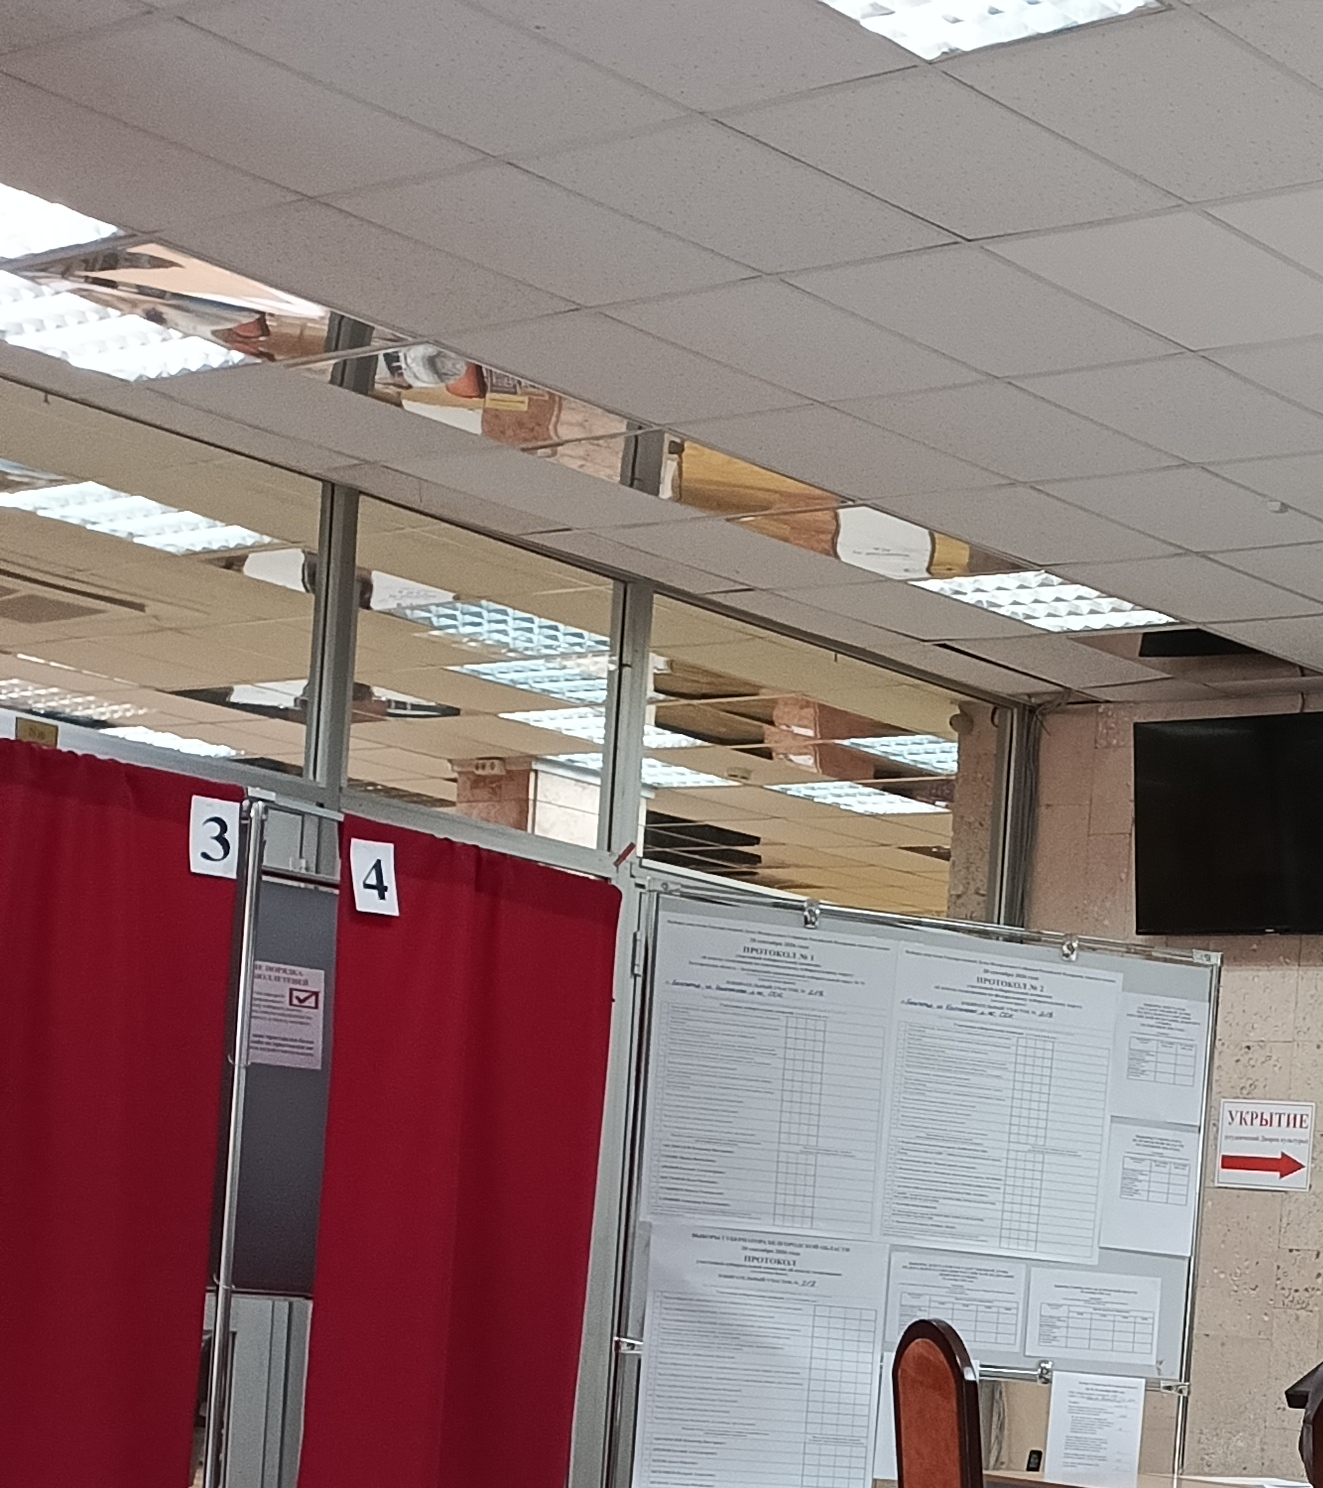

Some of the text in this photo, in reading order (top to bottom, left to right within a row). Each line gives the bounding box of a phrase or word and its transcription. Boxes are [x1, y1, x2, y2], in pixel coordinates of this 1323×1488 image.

[200, 816, 231, 862] 3
[362, 858, 389, 901] 4
[743, 946, 796, 959] ПРОТОКОЛ
[976, 977, 1027, 989] ПРОТОКОЛ
[1227, 1110, 1309, 1129] УКРЫТИЕ
[744, 1255, 796, 1266] ПРОТОКОЛ
